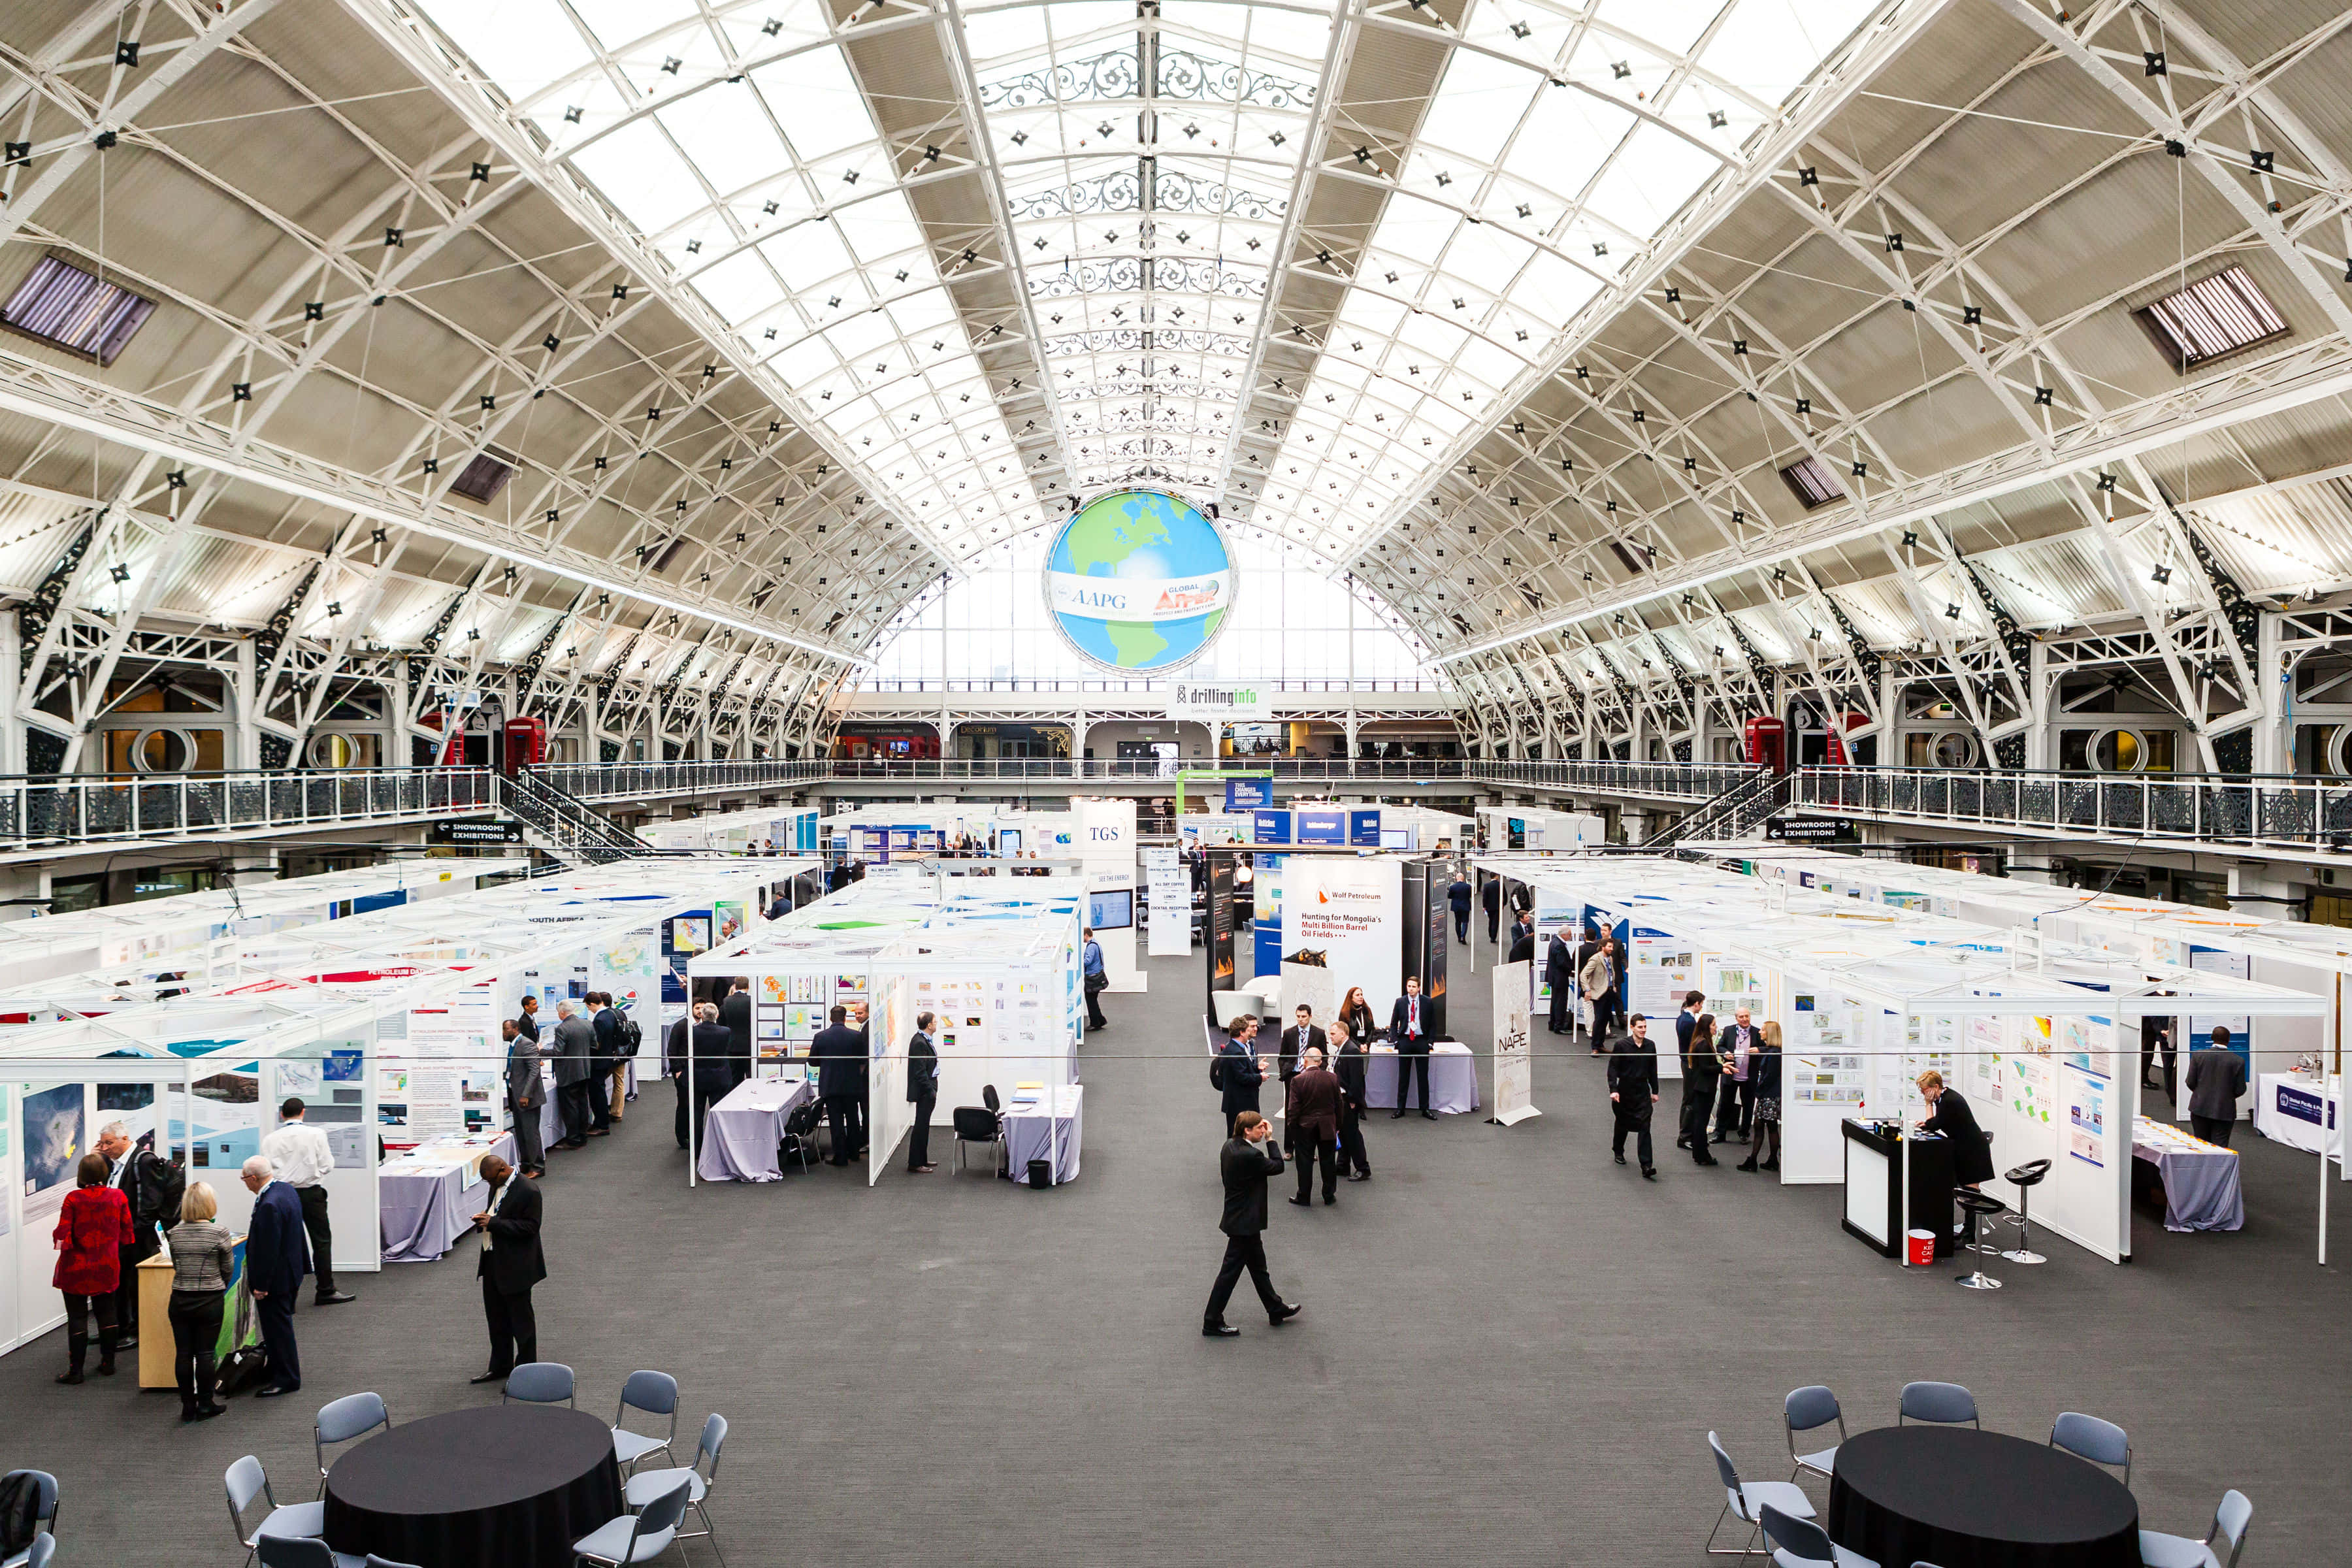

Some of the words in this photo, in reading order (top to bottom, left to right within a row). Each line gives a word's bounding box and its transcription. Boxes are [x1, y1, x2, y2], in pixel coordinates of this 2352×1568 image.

[1168, 583, 1200, 593] GLOBAL
[1071, 589, 1126, 610] AAPG
[1191, 689, 1256, 707] drillinginfo
[1090, 827, 1119, 841] TGS
[1301, 913, 1330, 922] Hunting
[1343, 915, 1381, 924] Mongolia's
[1499, 1032, 1526, 1053] NAPE
